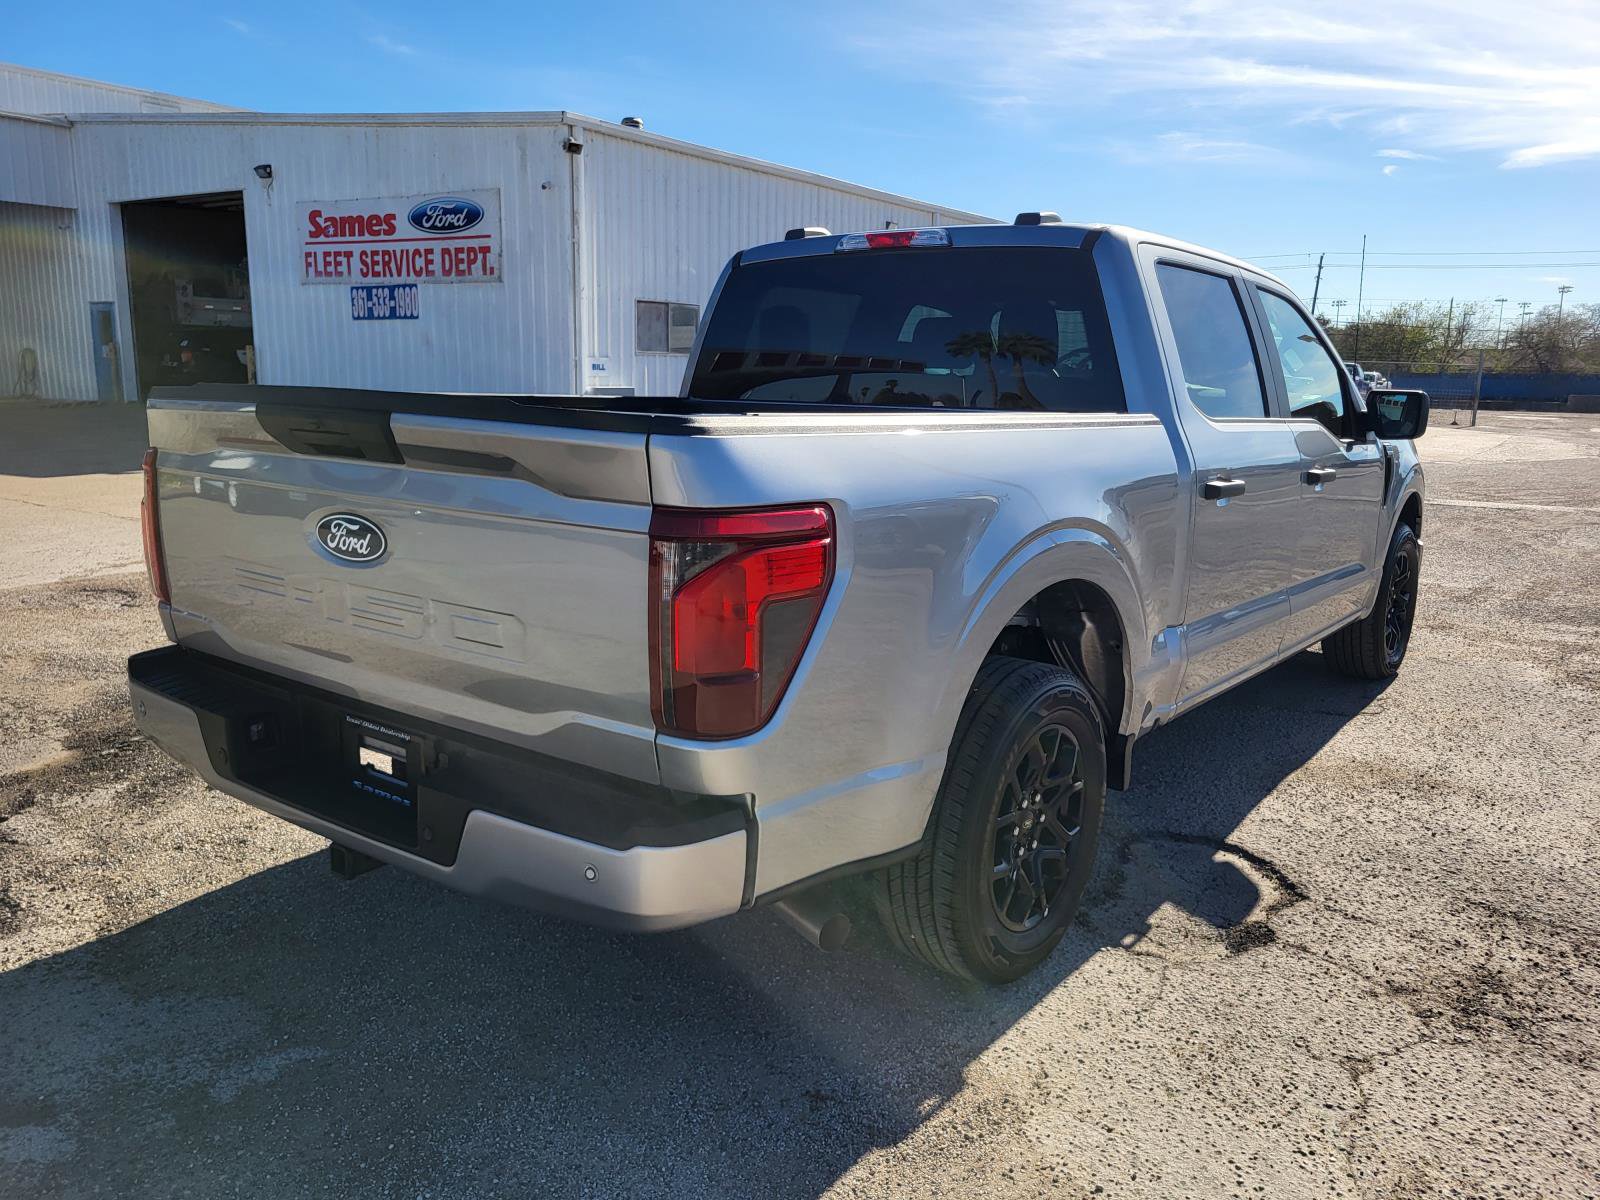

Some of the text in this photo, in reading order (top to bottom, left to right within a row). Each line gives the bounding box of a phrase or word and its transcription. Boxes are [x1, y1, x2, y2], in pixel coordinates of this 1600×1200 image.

[308, 209, 397, 239] Sames
[422, 203, 468, 229] Ford
[304, 246, 495, 278] FLEET SERVICE DEPT.
[351, 286, 419, 318] 361-533-1980
[326, 519, 371, 555] Ford
